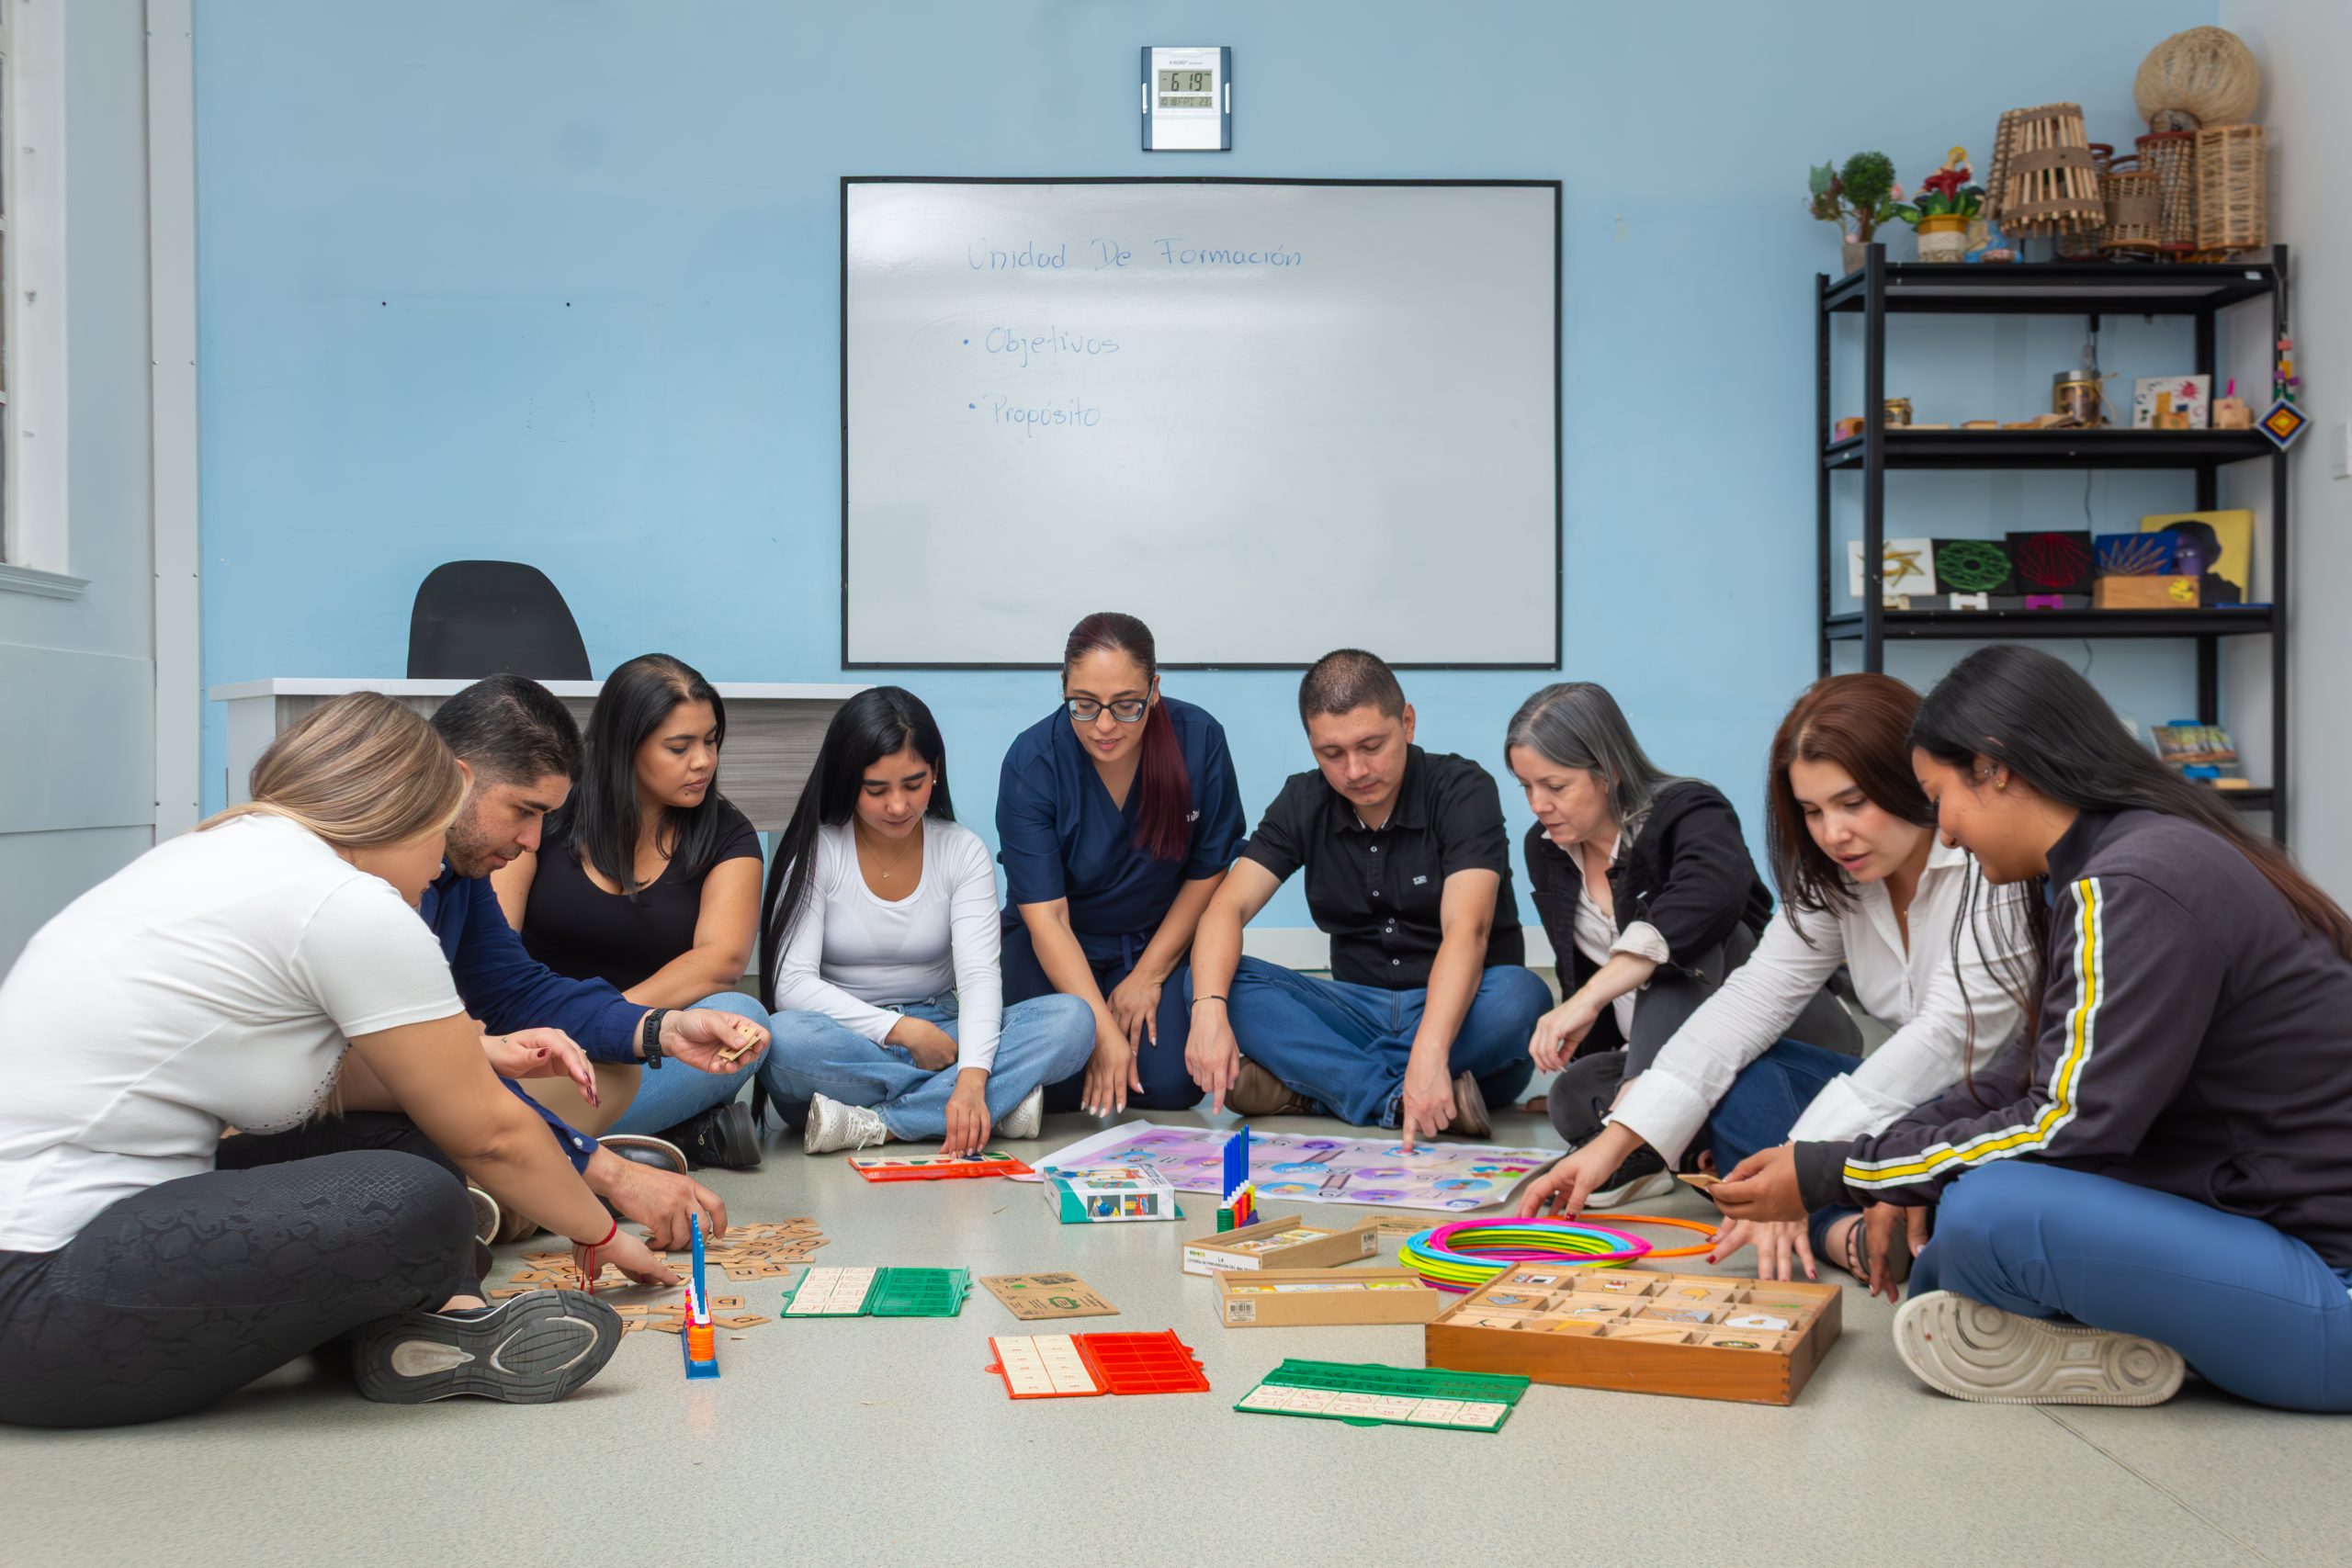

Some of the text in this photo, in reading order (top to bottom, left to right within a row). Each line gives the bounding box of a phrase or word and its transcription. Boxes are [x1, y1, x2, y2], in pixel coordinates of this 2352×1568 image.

[967, 237, 1302, 272] Unidad De Formación
[986, 324, 1120, 368] Objetivos
[982, 394, 1102, 438] Propósito
